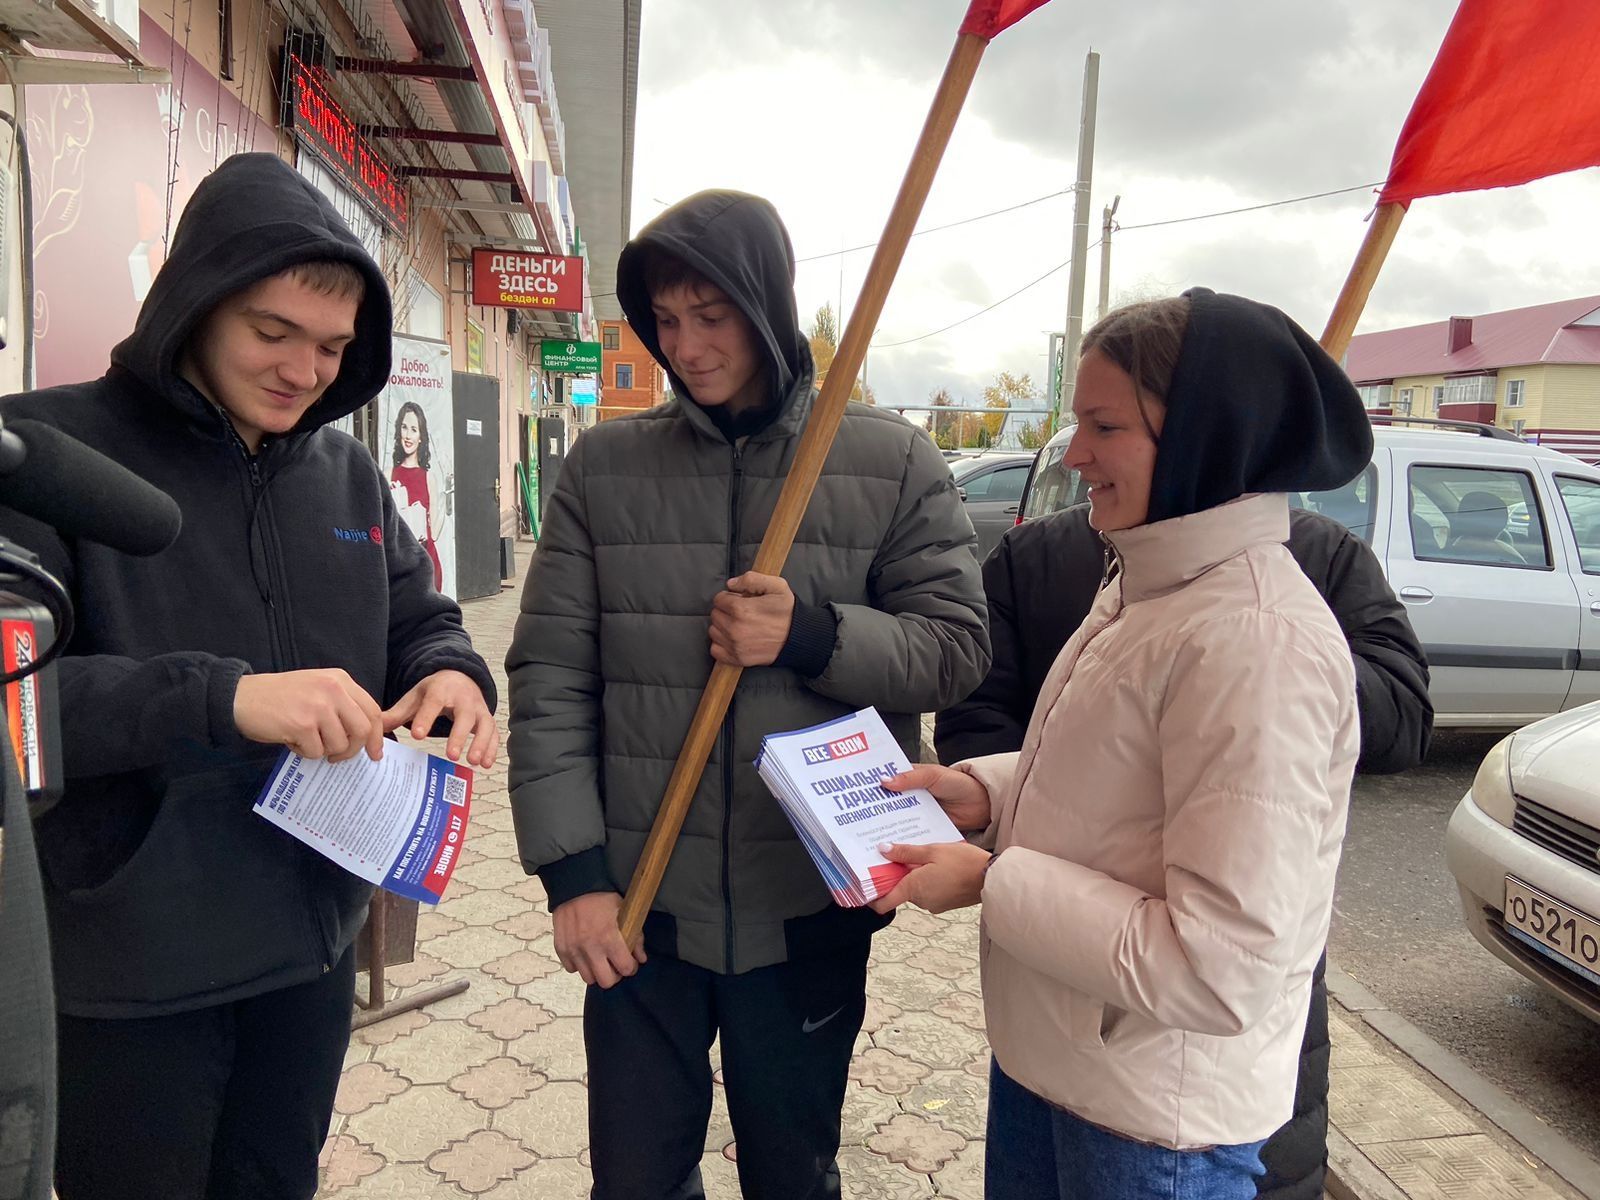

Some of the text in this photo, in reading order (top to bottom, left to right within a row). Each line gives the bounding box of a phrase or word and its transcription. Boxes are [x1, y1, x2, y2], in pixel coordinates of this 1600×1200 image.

[490, 255, 566, 275] ДЕНЬГИ
[498, 274, 559, 293] ЗДЕСЬ
[500, 292, 555, 304] бездән ал
[400, 358, 430, 375] Добро
[544, 354, 598, 363] ФИНАНСОВЫЙ
[25, 680, 36, 757] НОВОСТИ
[803, 736, 867, 763] ВСЕ СВОИ
[420, 797, 435, 827] ВОЕННУЮ
[834, 795, 921, 826] ВОЕННОСЛУЖАЩИХ
[416, 826, 426, 836] НА
[399, 835, 422, 868] ПОСТУПИТЬ
[433, 815, 462, 877] ЗВОНИ 117
[392, 863, 404, 881] КАК
